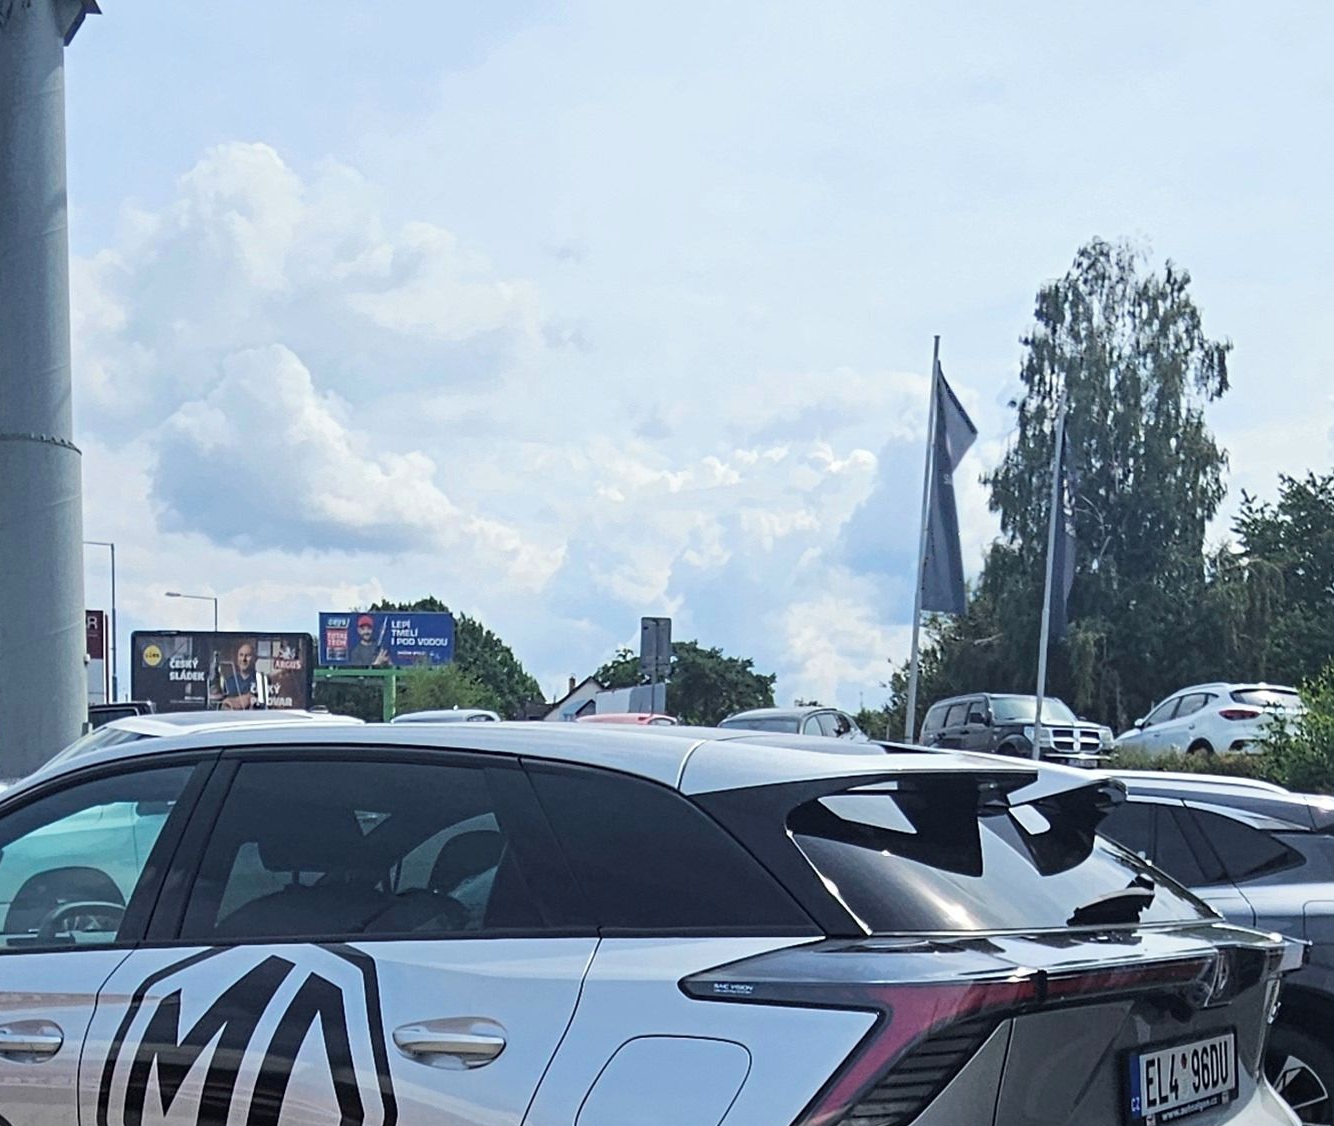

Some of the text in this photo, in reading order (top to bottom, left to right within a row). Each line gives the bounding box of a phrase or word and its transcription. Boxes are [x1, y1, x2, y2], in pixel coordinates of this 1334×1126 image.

[391, 619, 411, 629] LEPÍ
[391, 628, 418, 637] TMELÍ
[169, 657, 199, 669] ČESKÝ
[273, 660, 302, 670] ARGUS
[169, 671, 205, 682] SLÁDEK
[1146, 1041, 1228, 1108] EL4 96DU
[1131, 1097, 1140, 1112] CZ
